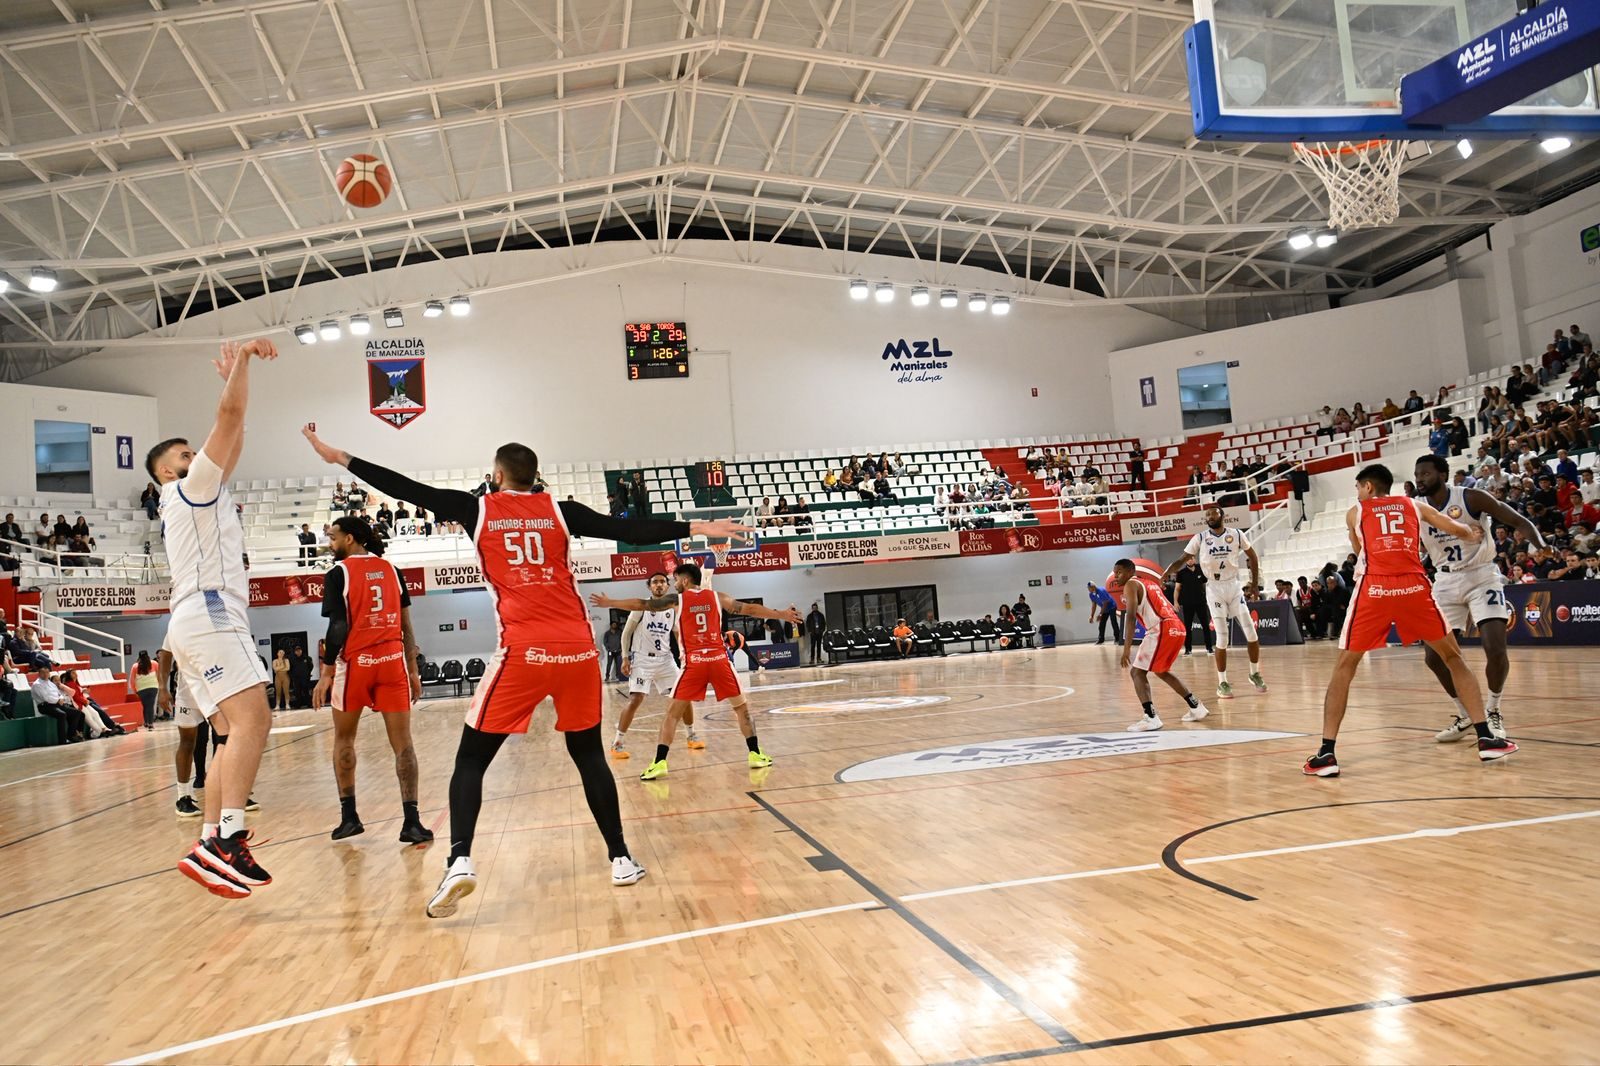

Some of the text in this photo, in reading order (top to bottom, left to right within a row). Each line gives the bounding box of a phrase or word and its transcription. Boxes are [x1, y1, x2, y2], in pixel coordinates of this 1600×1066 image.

[1509, 6, 1568, 46] ALCALDÍA
[1509, 20, 1569, 57] DE MANIZALES
[1457, 37, 1496, 69] MZL
[633, 330, 683, 342] 39 2 29
[366, 337, 425, 350] ALCALDÍA
[882, 337, 953, 360] MZL
[379, 349, 426, 357] MANIZALES
[653, 348, 673, 359] 1:26
[890, 360, 948, 371] Manizales
[631, 367, 638, 378] 3
[897, 371, 943, 383] del alma
[707, 470, 723, 486] 10
[525, 517, 555, 530] ANDRÉ
[1160, 524, 1187, 532] CALDAS
[1375, 511, 1405, 535] 12
[969, 532, 985, 541] RON
[1074, 528, 1097, 536] RON
[908, 537, 930, 545] RON
[1085, 533, 1120, 543] SABEN
[503, 531, 545, 565] 50
[798, 539, 877, 552] LO TUYO ES EL RON
[918, 542, 951, 551] SABEN
[961, 543, 992, 552] CALDAS
[1209, 545, 1232, 555] MZL
[737, 551, 763, 560] RON
[798, 548, 878, 561] VIEJO DE CALDAS
[1443, 544, 1462, 561] 21
[623, 555, 639, 565] RON
[750, 557, 788, 567] SABEN
[435, 567, 447, 576] LO
[448, 566, 474, 575] TUYO
[572, 566, 602, 574] ABEN
[613, 567, 648, 576] CALDAS
[435, 575, 480, 585] VIEJO DE
[56, 587, 136, 597] LO TUYO ES EL RON
[249, 593, 269, 602] DAS
[1485, 589, 1504, 606] 21
[57, 597, 136, 607] VIEJO DE CALDAS
[369, 585, 384, 613] 3
[646, 621, 669, 632] MZL
[695, 613, 707, 633] 9
[1258, 617, 1280, 628] MIYAGI
[655, 639, 661, 650] 8
[204, 664, 224, 677] MZL
[914, 735, 1160, 761] MZL
